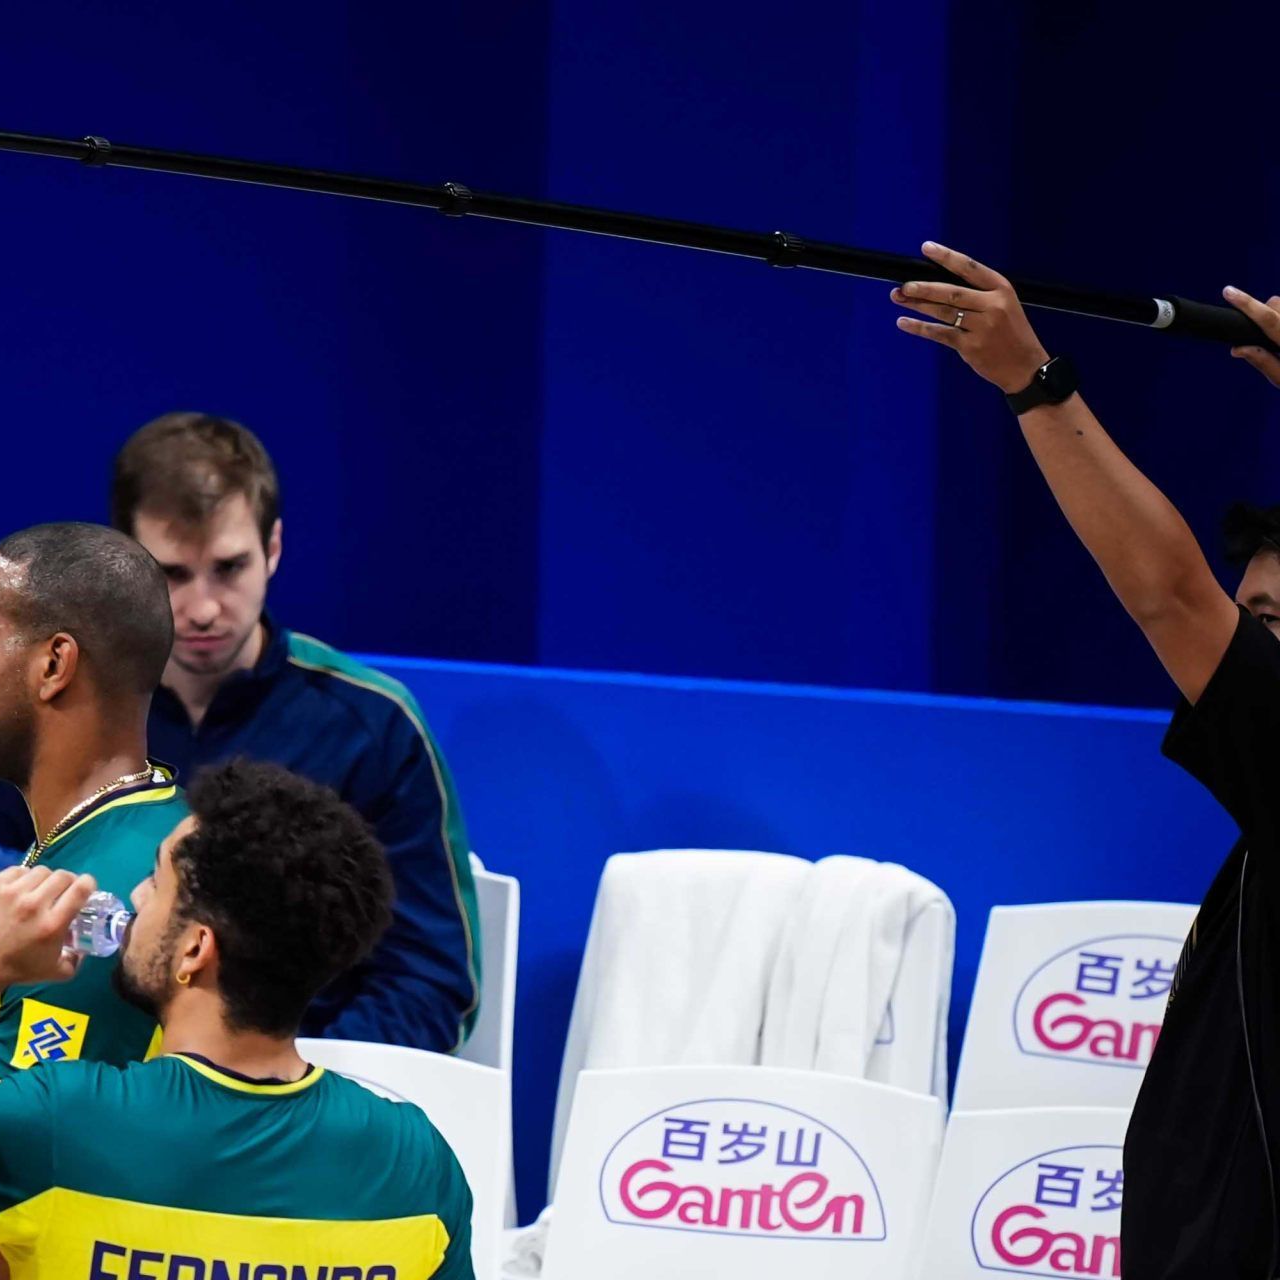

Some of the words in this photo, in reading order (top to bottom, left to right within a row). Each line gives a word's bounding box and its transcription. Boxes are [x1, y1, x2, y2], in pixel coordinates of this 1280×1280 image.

[1074, 951, 1177, 1001] 百岁
[661, 1116, 823, 1168] 百岁山
[1034, 1162, 1124, 1213] 百岁
